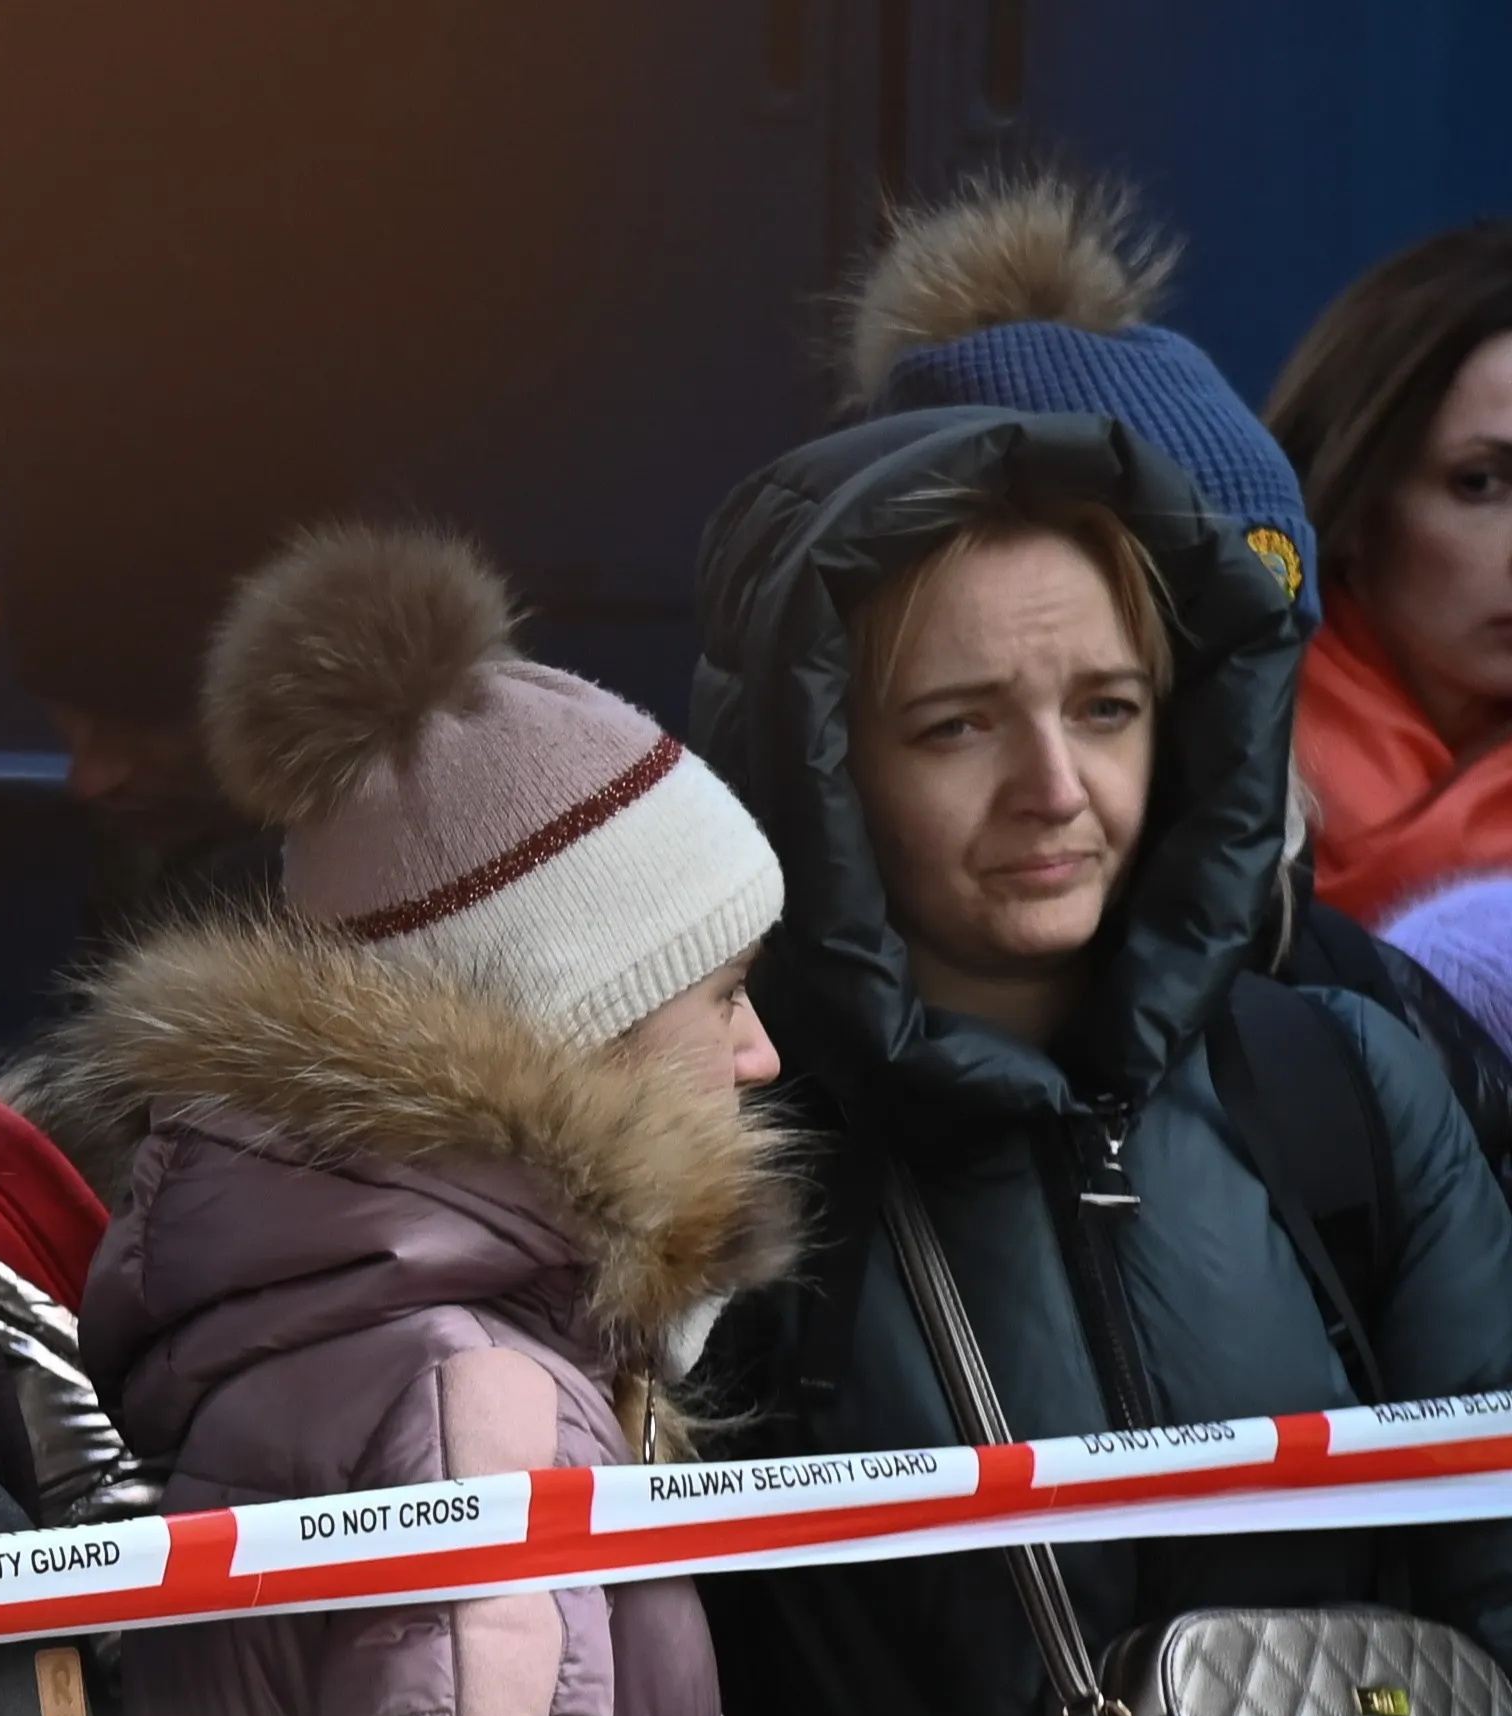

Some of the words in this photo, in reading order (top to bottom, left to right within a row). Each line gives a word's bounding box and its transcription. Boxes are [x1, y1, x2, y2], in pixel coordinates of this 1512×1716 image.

[649, 1469, 743, 1502] RAILWAY
[751, 1460, 855, 1491] SECURITY
[860, 1453, 937, 1480] GUARD
[299, 1512, 335, 1541] DO
[342, 1505, 391, 1536] NOT
[399, 1495, 480, 1529] CROSS
[30, 1540, 120, 1575] GUARD
